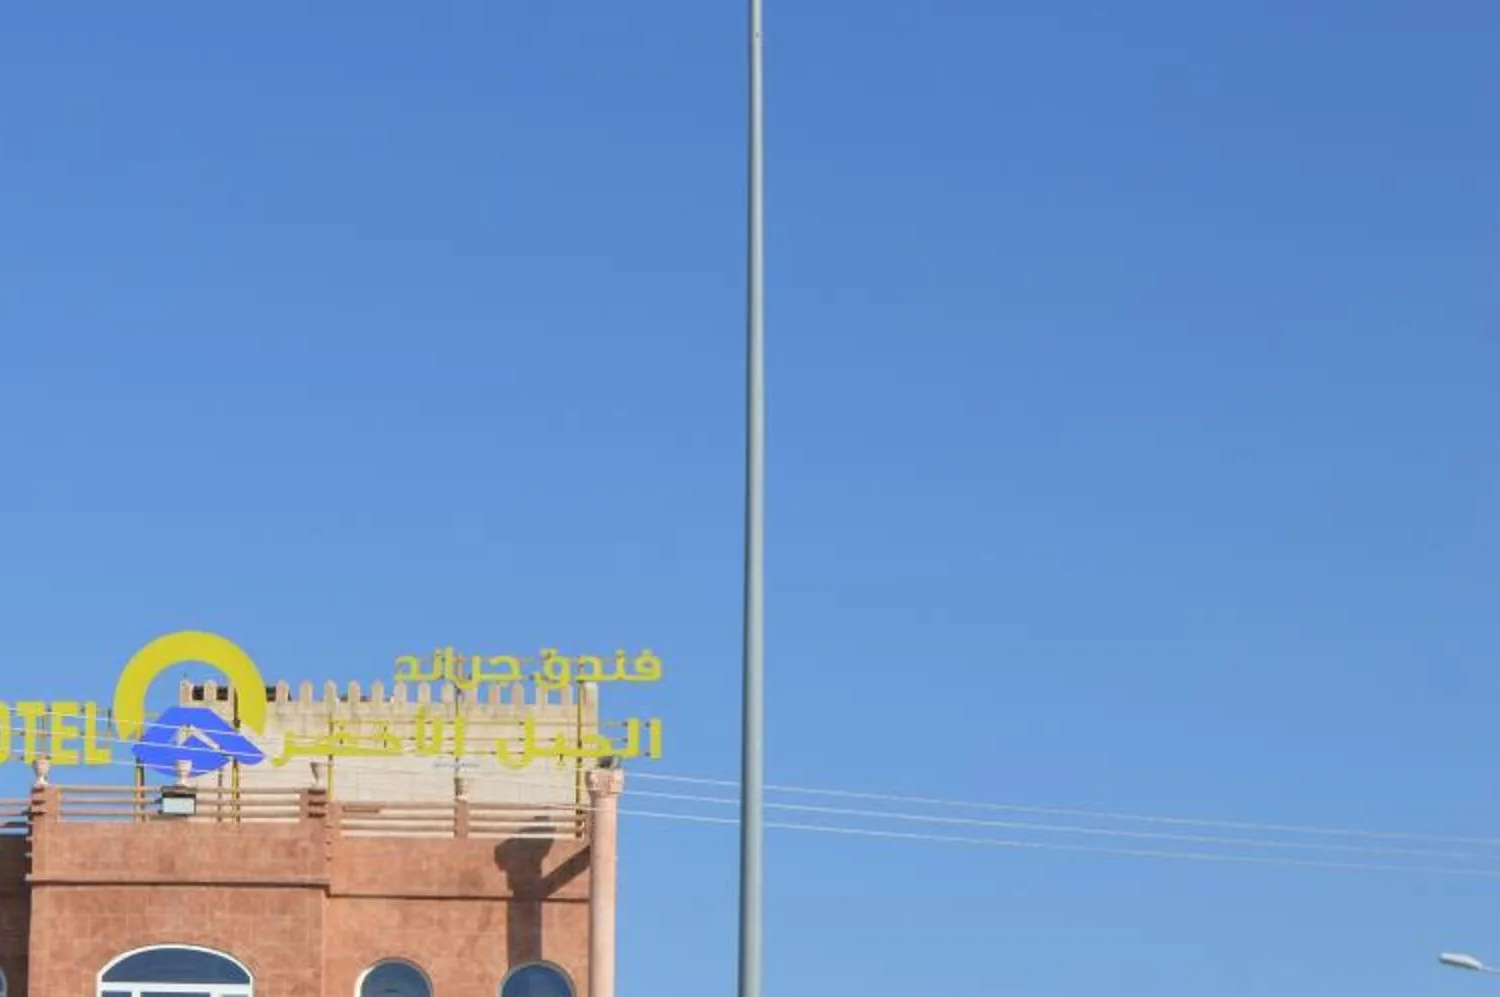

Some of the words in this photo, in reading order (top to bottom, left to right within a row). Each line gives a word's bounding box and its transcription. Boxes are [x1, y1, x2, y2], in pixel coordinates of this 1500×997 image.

[394, 646, 522, 692] جراند
[534, 648, 662, 695] فندق
[494, 707, 663, 770] الجبل
